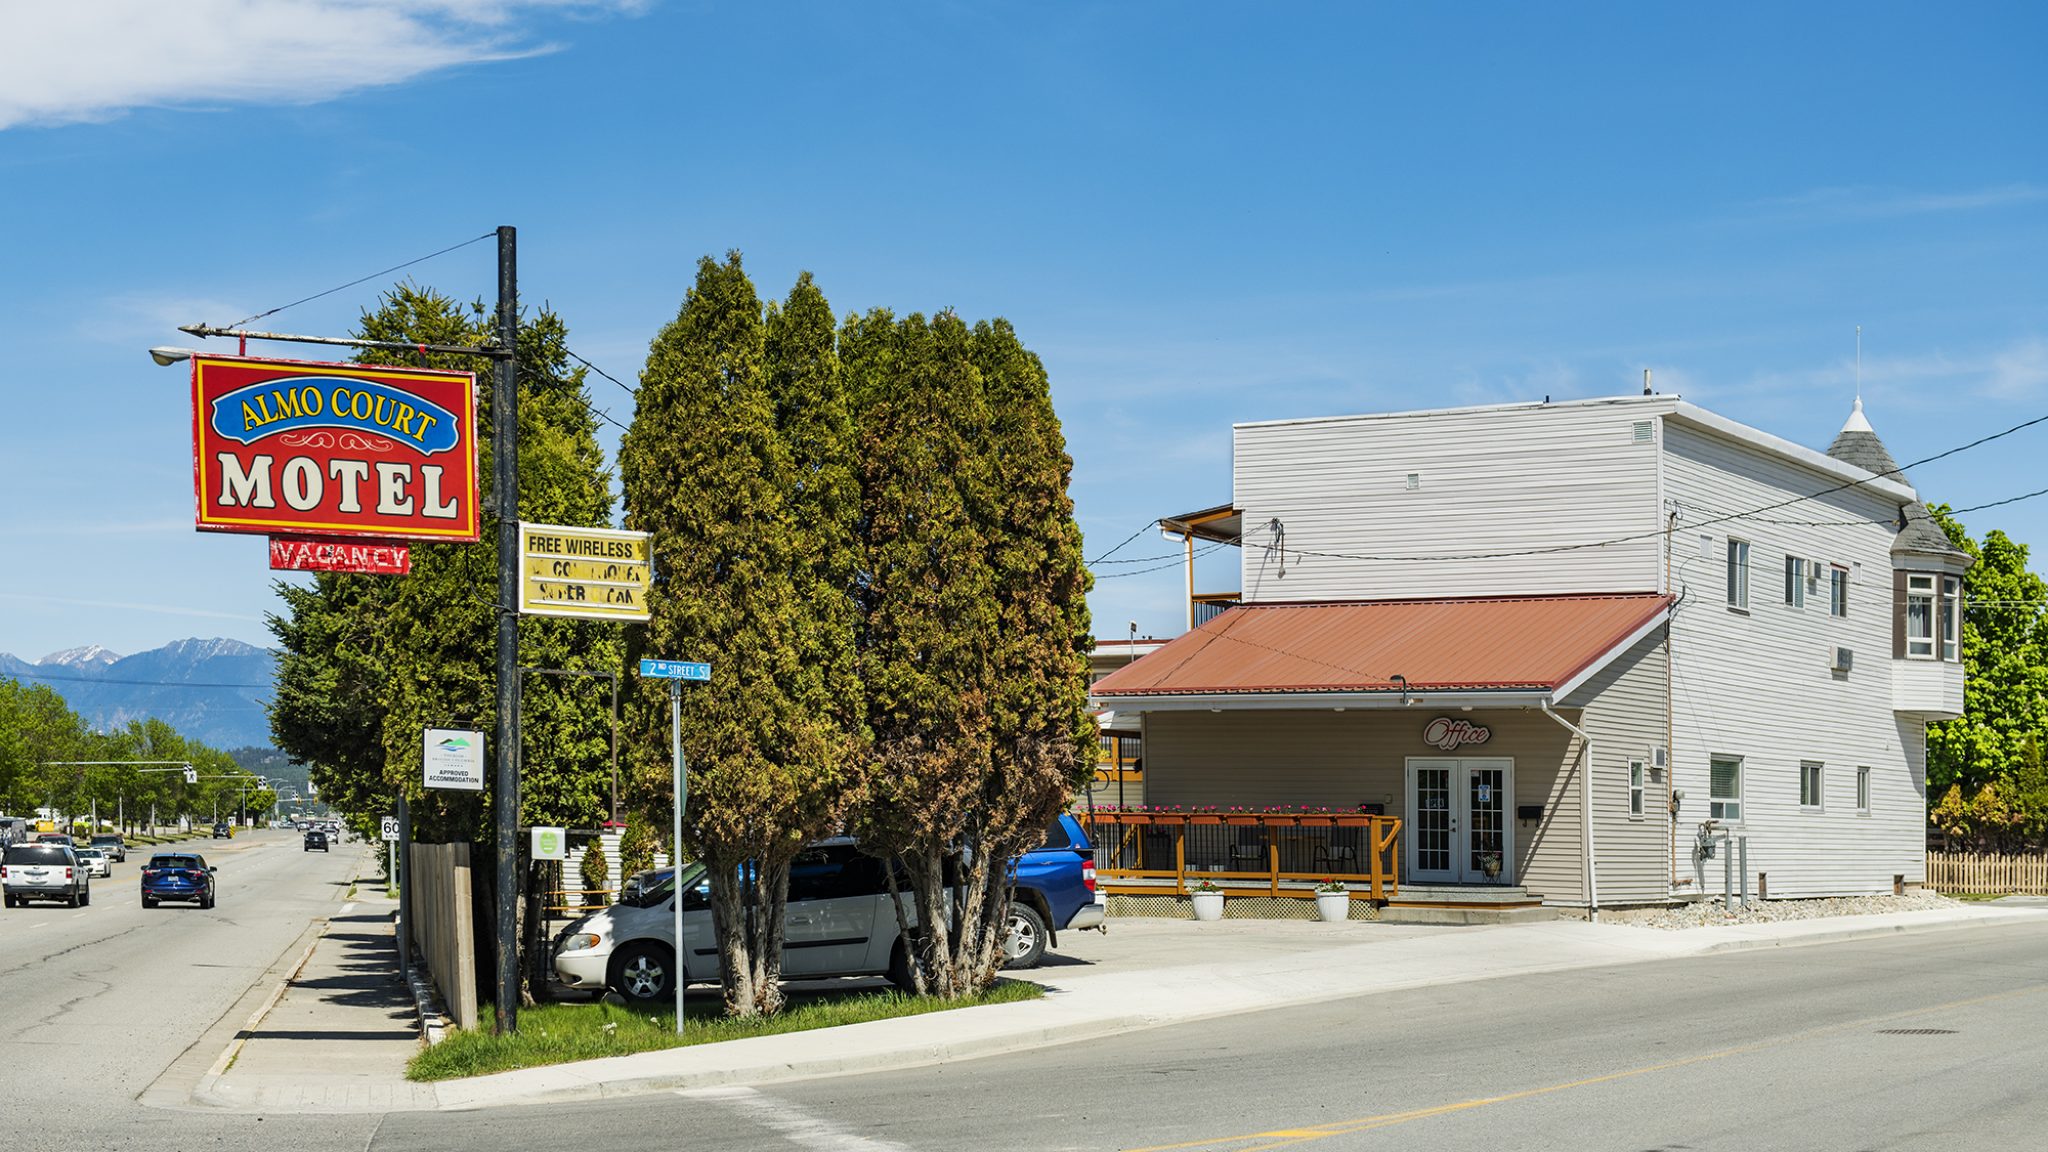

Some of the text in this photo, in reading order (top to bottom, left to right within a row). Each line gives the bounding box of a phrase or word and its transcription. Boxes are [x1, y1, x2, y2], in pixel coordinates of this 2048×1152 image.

[241, 386, 437, 442] ALMO COURT
[217, 452, 458, 519] MOTEL
[279, 543, 406, 569] VACANCY
[529, 536, 633, 558] FREE WIRELESS
[668, 665, 694, 676] STREET
[1425, 719, 1489, 749] Office
[429, 775, 479, 783] ACCOMMODATION
[439, 769, 469, 777] APPROVED
[384, 822, 400, 833] 60
